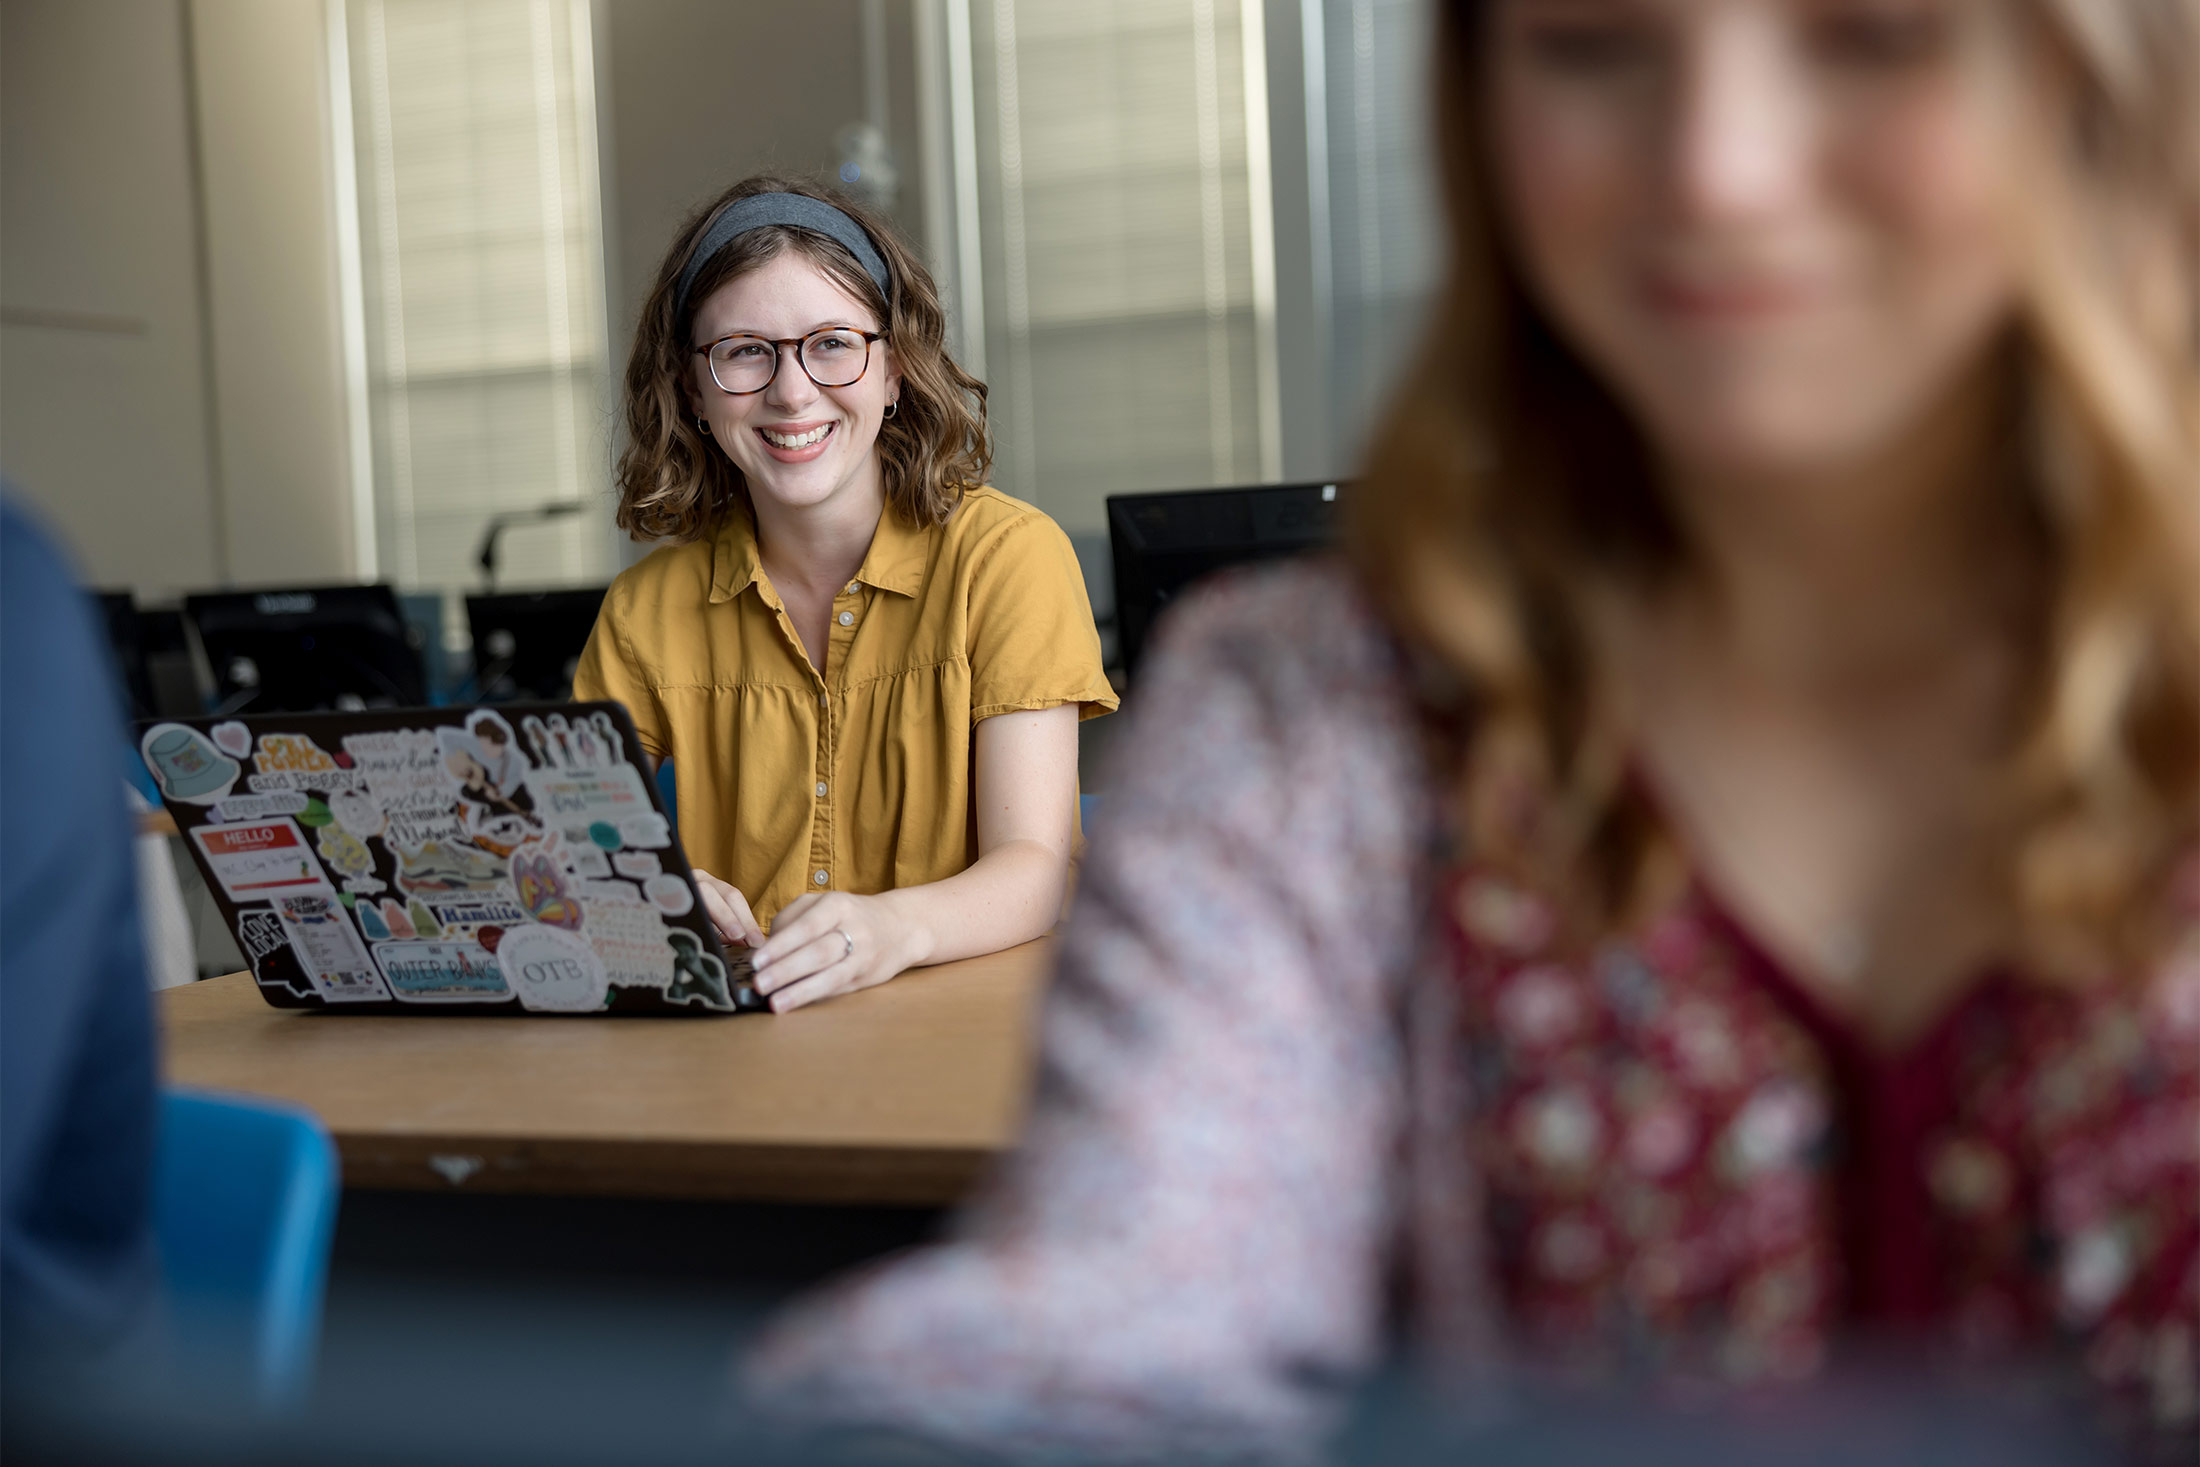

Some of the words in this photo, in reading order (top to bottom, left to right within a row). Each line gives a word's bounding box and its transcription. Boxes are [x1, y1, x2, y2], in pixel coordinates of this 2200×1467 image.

[252, 773, 289, 790] and
[223, 828, 275, 846] HELLO
[442, 904, 522, 923] Hamilto
[243, 911, 281, 941] LOVE
[246, 927, 290, 958] LOCAL
[388, 959, 442, 981] OUTER
[447, 957, 501, 981] BANKS
[522, 957, 583, 984] OTB
